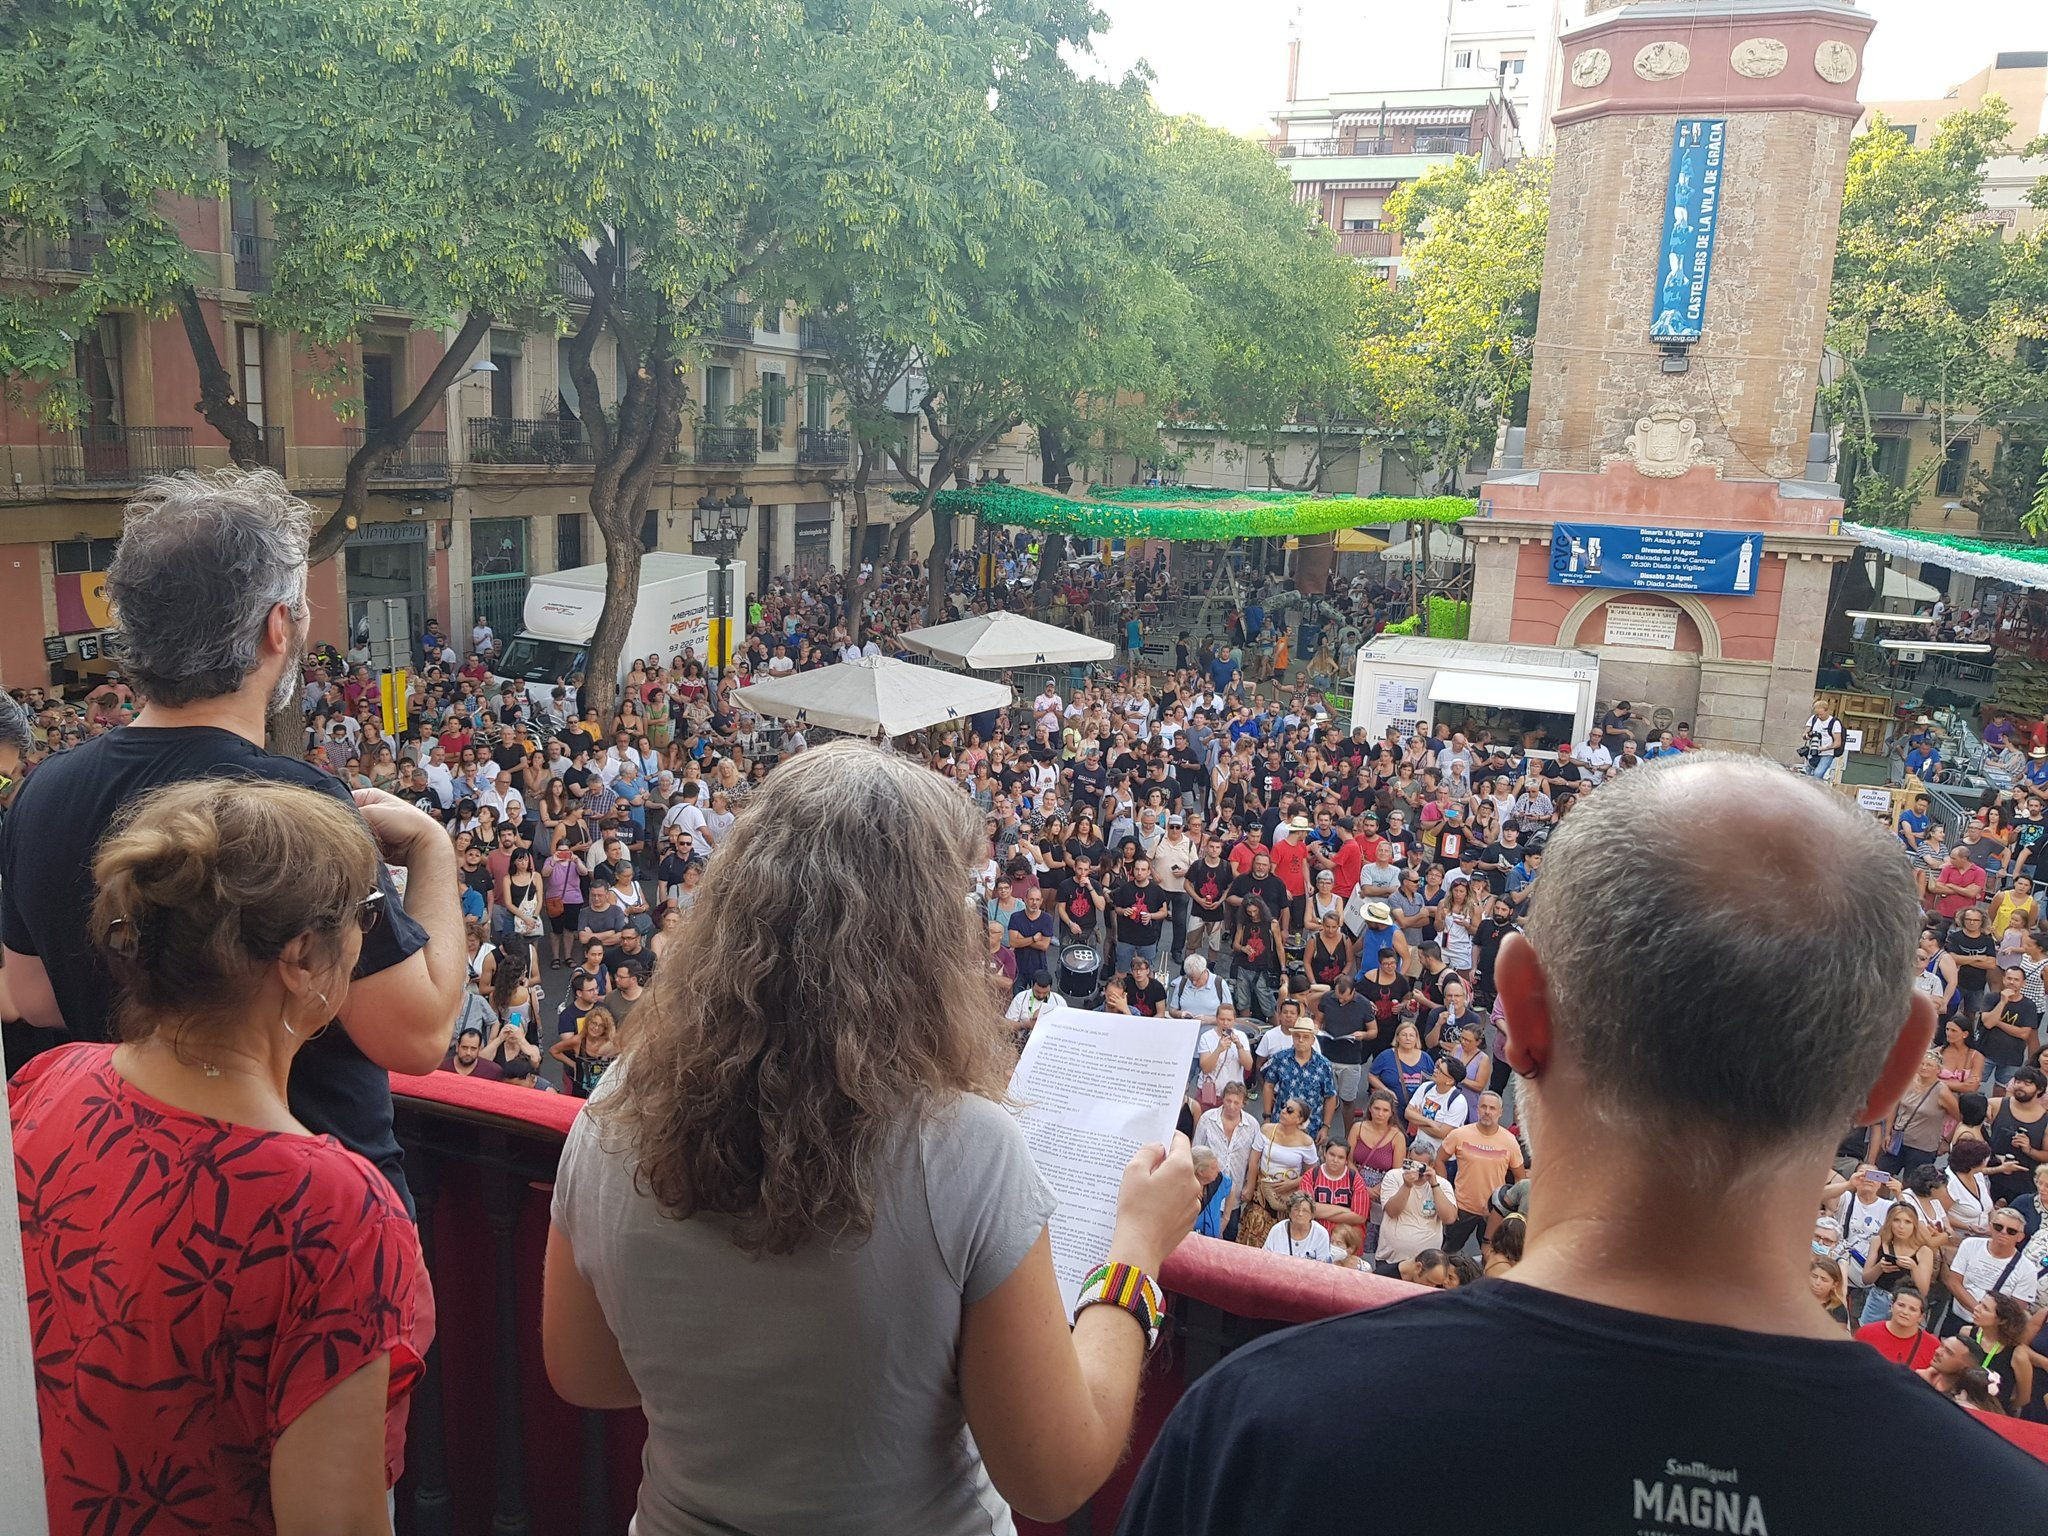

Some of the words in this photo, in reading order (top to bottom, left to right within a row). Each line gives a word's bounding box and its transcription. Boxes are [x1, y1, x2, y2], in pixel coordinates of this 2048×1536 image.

[1705, 122, 1724, 166] GRÀCIA
[1704, 170, 1718, 184] DE
[1700, 186, 1716, 214] VILA
[1698, 216, 1712, 232] LA
[1696, 235, 1710, 248] DE
[1687, 251, 1707, 320] CASTELLERS
[1553, 536, 1570, 572] CVG
[1666, 581, 1698, 589] Castellera
[669, 616, 702, 634] RENT
[669, 643, 679, 652] 93
[680, 639, 694, 649] 222
[696, 635, 704, 644] 03
[1664, 1458, 1738, 1484] SanMiguel
[1633, 1478, 1768, 1536] MAGNA
